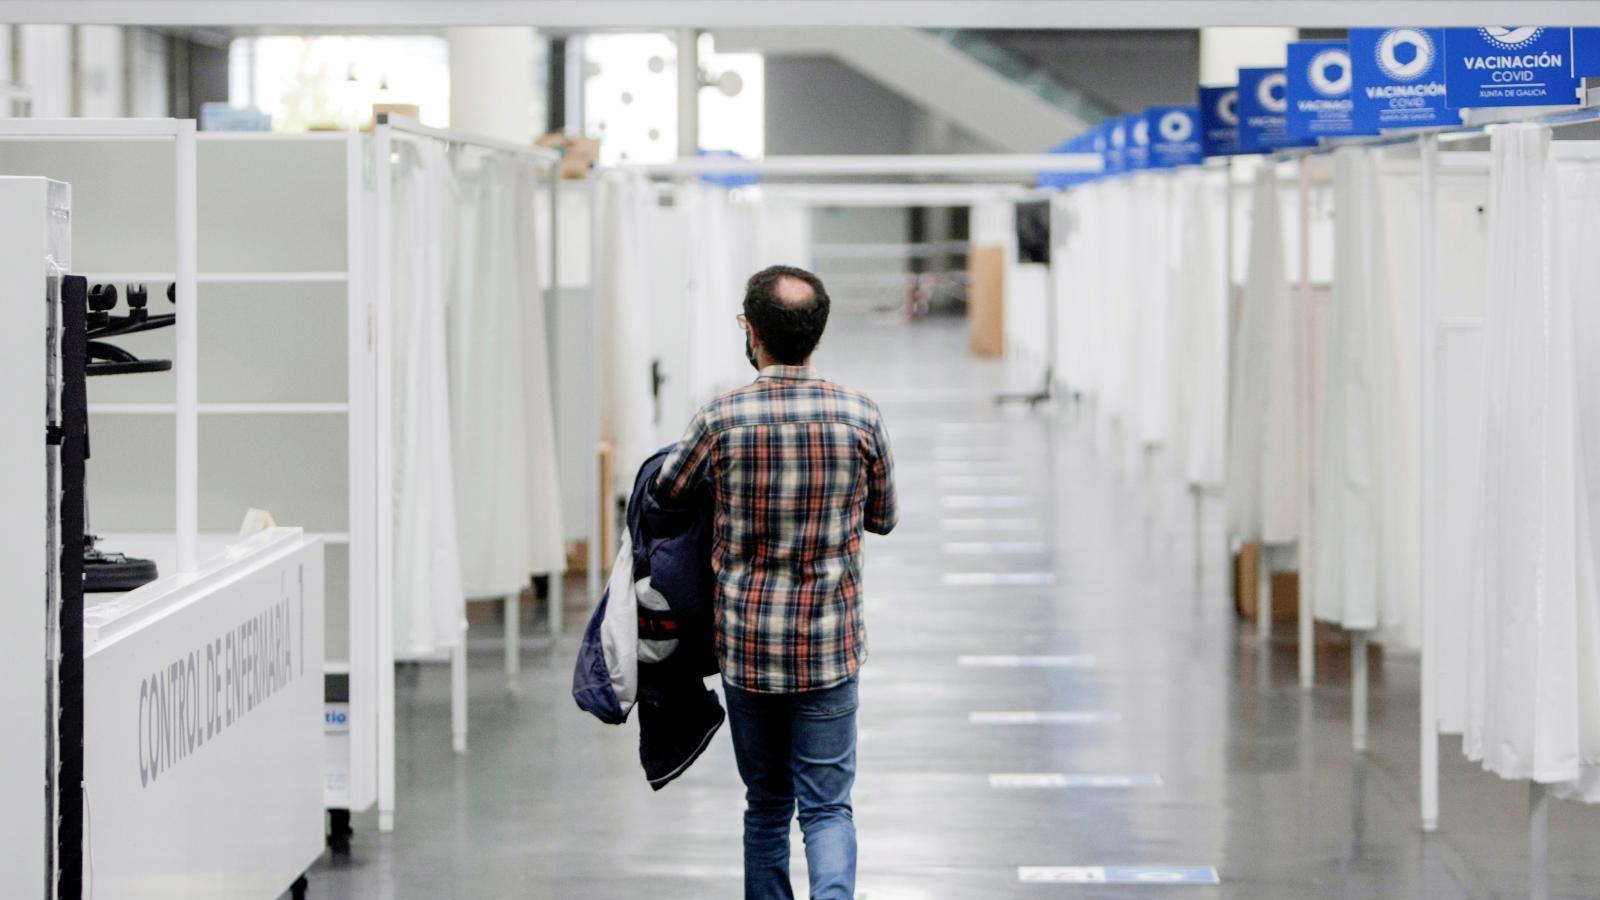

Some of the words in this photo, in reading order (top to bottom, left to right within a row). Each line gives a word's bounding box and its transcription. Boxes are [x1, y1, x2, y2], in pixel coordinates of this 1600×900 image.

[1464, 51, 1562, 70] VACINACIÓN
[1492, 71, 1534, 82] COVID
[1366, 81, 1446, 98] VACINACIÓN
[1516, 89, 1547, 97] GALICIA
[1389, 97, 1425, 108] COVID
[139, 649, 203, 788] CONTROL
[206, 638, 222, 741] DE
[226, 569, 292, 728] ENFERMARÍA
